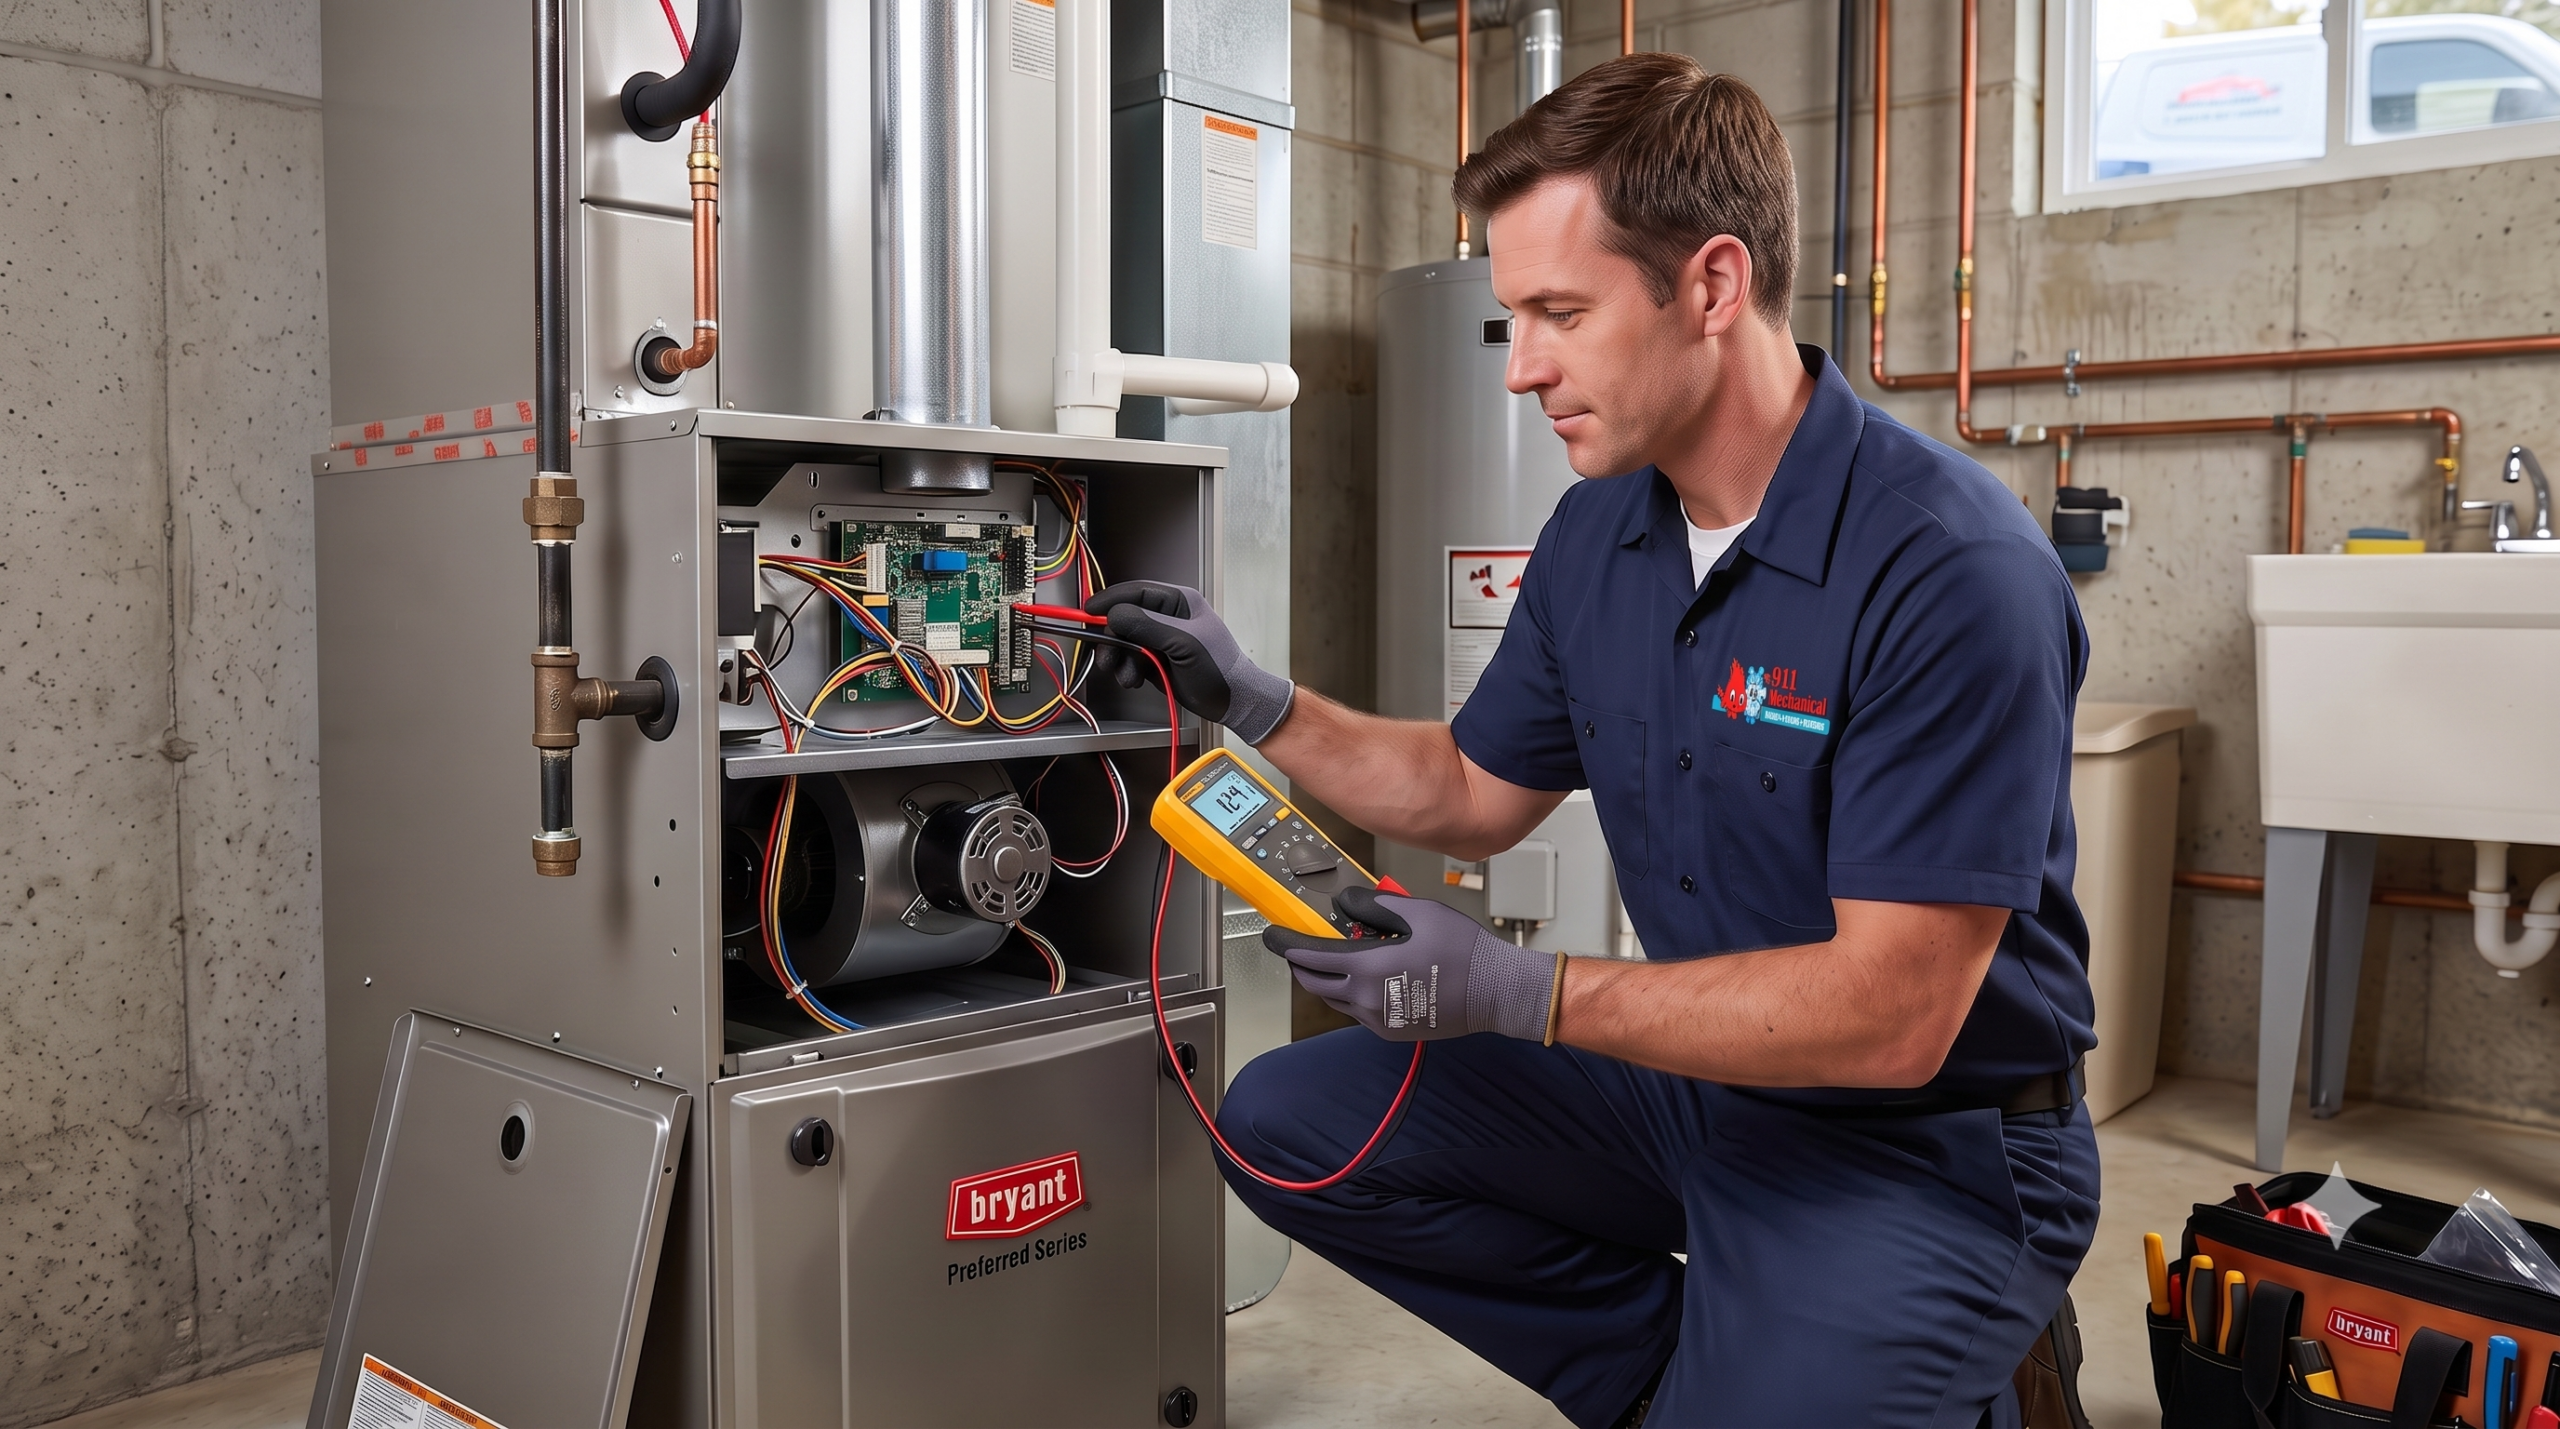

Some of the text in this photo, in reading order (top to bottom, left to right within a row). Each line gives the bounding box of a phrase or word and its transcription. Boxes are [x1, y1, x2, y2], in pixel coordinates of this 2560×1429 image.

[1768, 690, 1827, 715] Mechanical
[970, 1168, 1067, 1225] bryant
[948, 1232, 1088, 1286] Preferred Series
[2335, 1314, 2391, 1345] bryant
